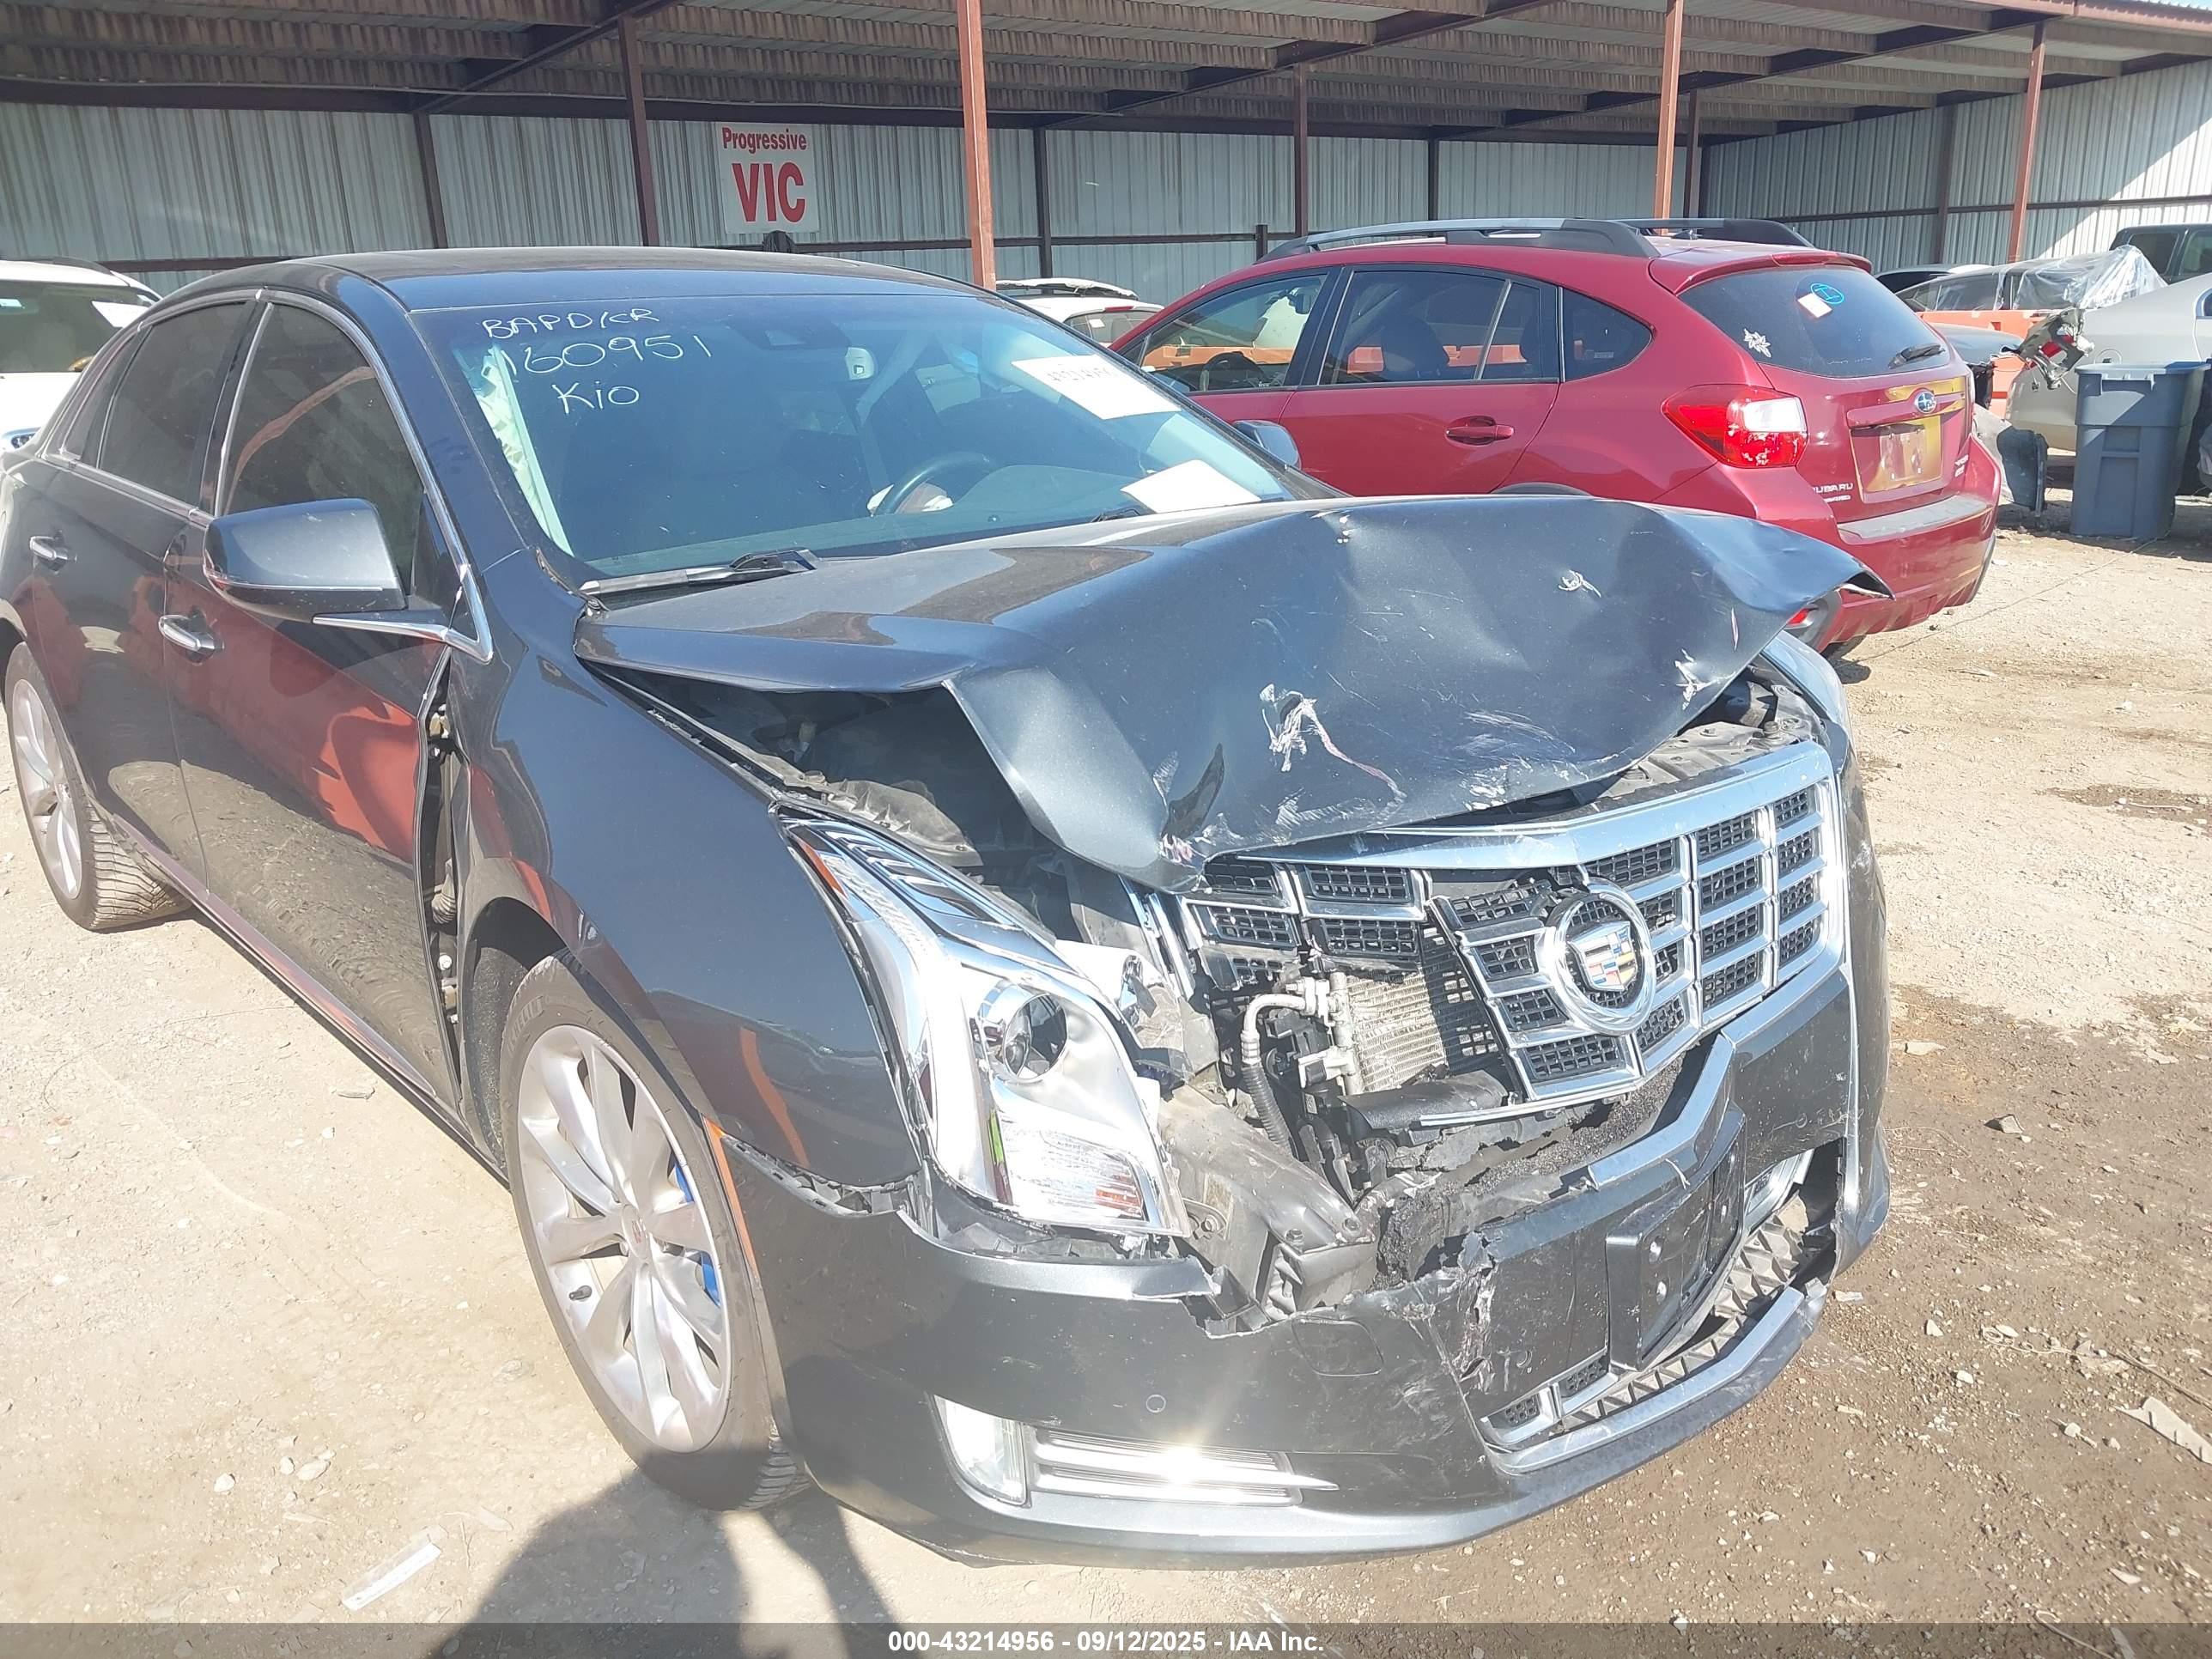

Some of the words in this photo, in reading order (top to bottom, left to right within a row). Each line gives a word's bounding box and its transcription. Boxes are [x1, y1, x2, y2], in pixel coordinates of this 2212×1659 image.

[722, 127, 807, 155] Progressive
[732, 161, 805, 223] VIC
[500, 334, 712, 376] 160951
[1813, 483, 1853, 494] UBARU
